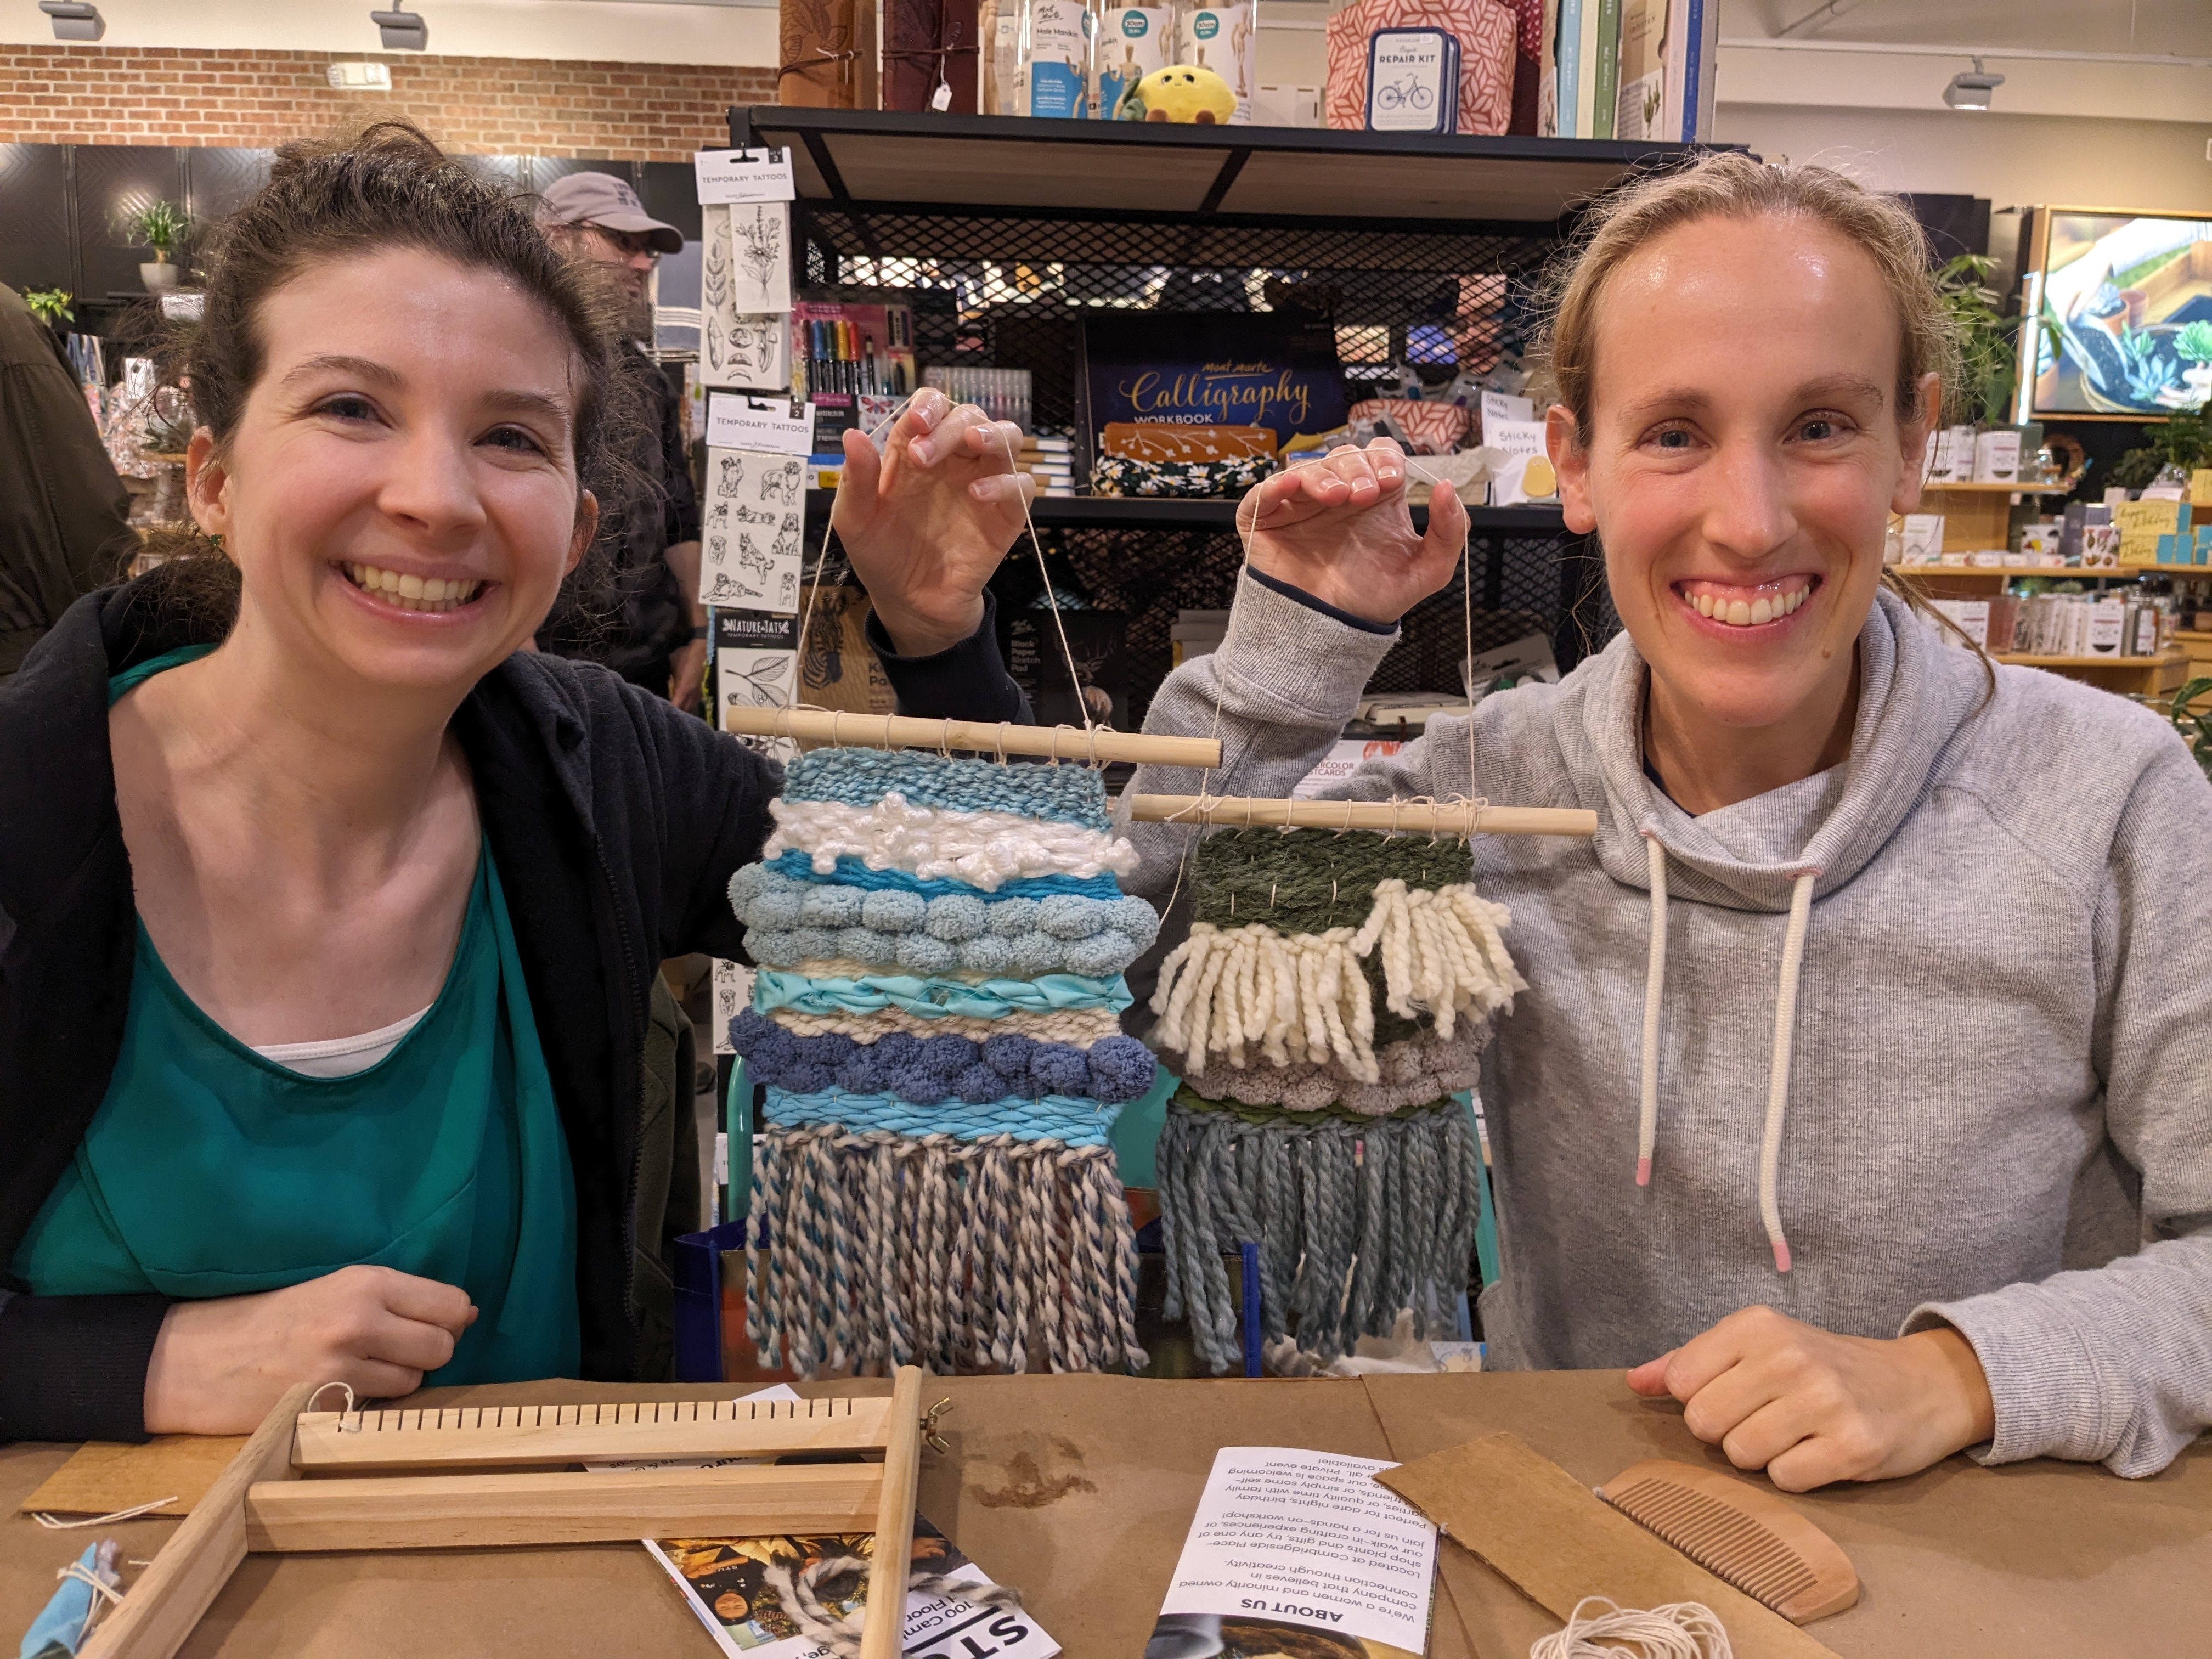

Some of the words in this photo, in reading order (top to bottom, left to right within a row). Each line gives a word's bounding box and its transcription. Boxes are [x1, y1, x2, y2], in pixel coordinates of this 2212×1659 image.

[1380, 55, 1415, 64] REPAIR
[1118, 370, 1312, 425] Calligraphy
[1134, 413, 1214, 424] WORKBOOK
[717, 417, 768, 428] TEMPORARY
[772, 423, 809, 433] TATTOOS
[1301, 1465, 1340, 1475] Private
[1318, 1459, 1375, 1470] available!
[1228, 1468, 1291, 1476] welcoming
[1308, 1474, 1344, 1482] space
[1300, 1481, 1339, 1491] simply
[1235, 1493, 1285, 1503] birthday
[1323, 1493, 1364, 1504] quality
[1359, 1490, 1401, 1503] friends,
[1290, 1498, 1328, 1508] nights,
[1333, 1505, 1361, 1513] date
[1222, 1511, 1284, 1521] workshop!
[1385, 1514, 1426, 1528] Perfect
[1221, 1522, 1296, 1531] experiences,
[1288, 1517, 1348, 1531] hands-on
[1266, 1532, 1282, 1541] try
[1300, 1527, 1348, 1539] crafting
[1287, 1535, 1314, 1544] gifts,
[1353, 1537, 1398, 1550] walk-in
[1402, 1538, 1424, 1549] join
[1250, 1543, 1348, 1560] Cambridgeside
[1347, 1546, 1386, 1559] plants
[1402, 1549, 1423, 1557] our
[1224, 1560, 1285, 1571] creativity.
[1390, 1555, 1421, 1567] shop
[1290, 1566, 1340, 1581] through
[1369, 1561, 1420, 1578] Located
[1226, 1580, 1279, 1592] minority
[1266, 1575, 1318, 1588] believes
[1283, 1588, 1309, 1596] and
[1323, 1583, 1348, 1593] that
[1345, 1577, 1417, 1599] connection
[1241, 1599, 1266, 1610] US
[1313, 1592, 1362, 1606] women
[1353, 1588, 1416, 1610] company
[906, 1598, 947, 1622] Floor
[945, 1601, 974, 1618] 100
[1271, 1602, 1344, 1622] ABOUT
[1379, 1607, 1414, 1622] We're
[922, 1616, 1029, 1659] ST
